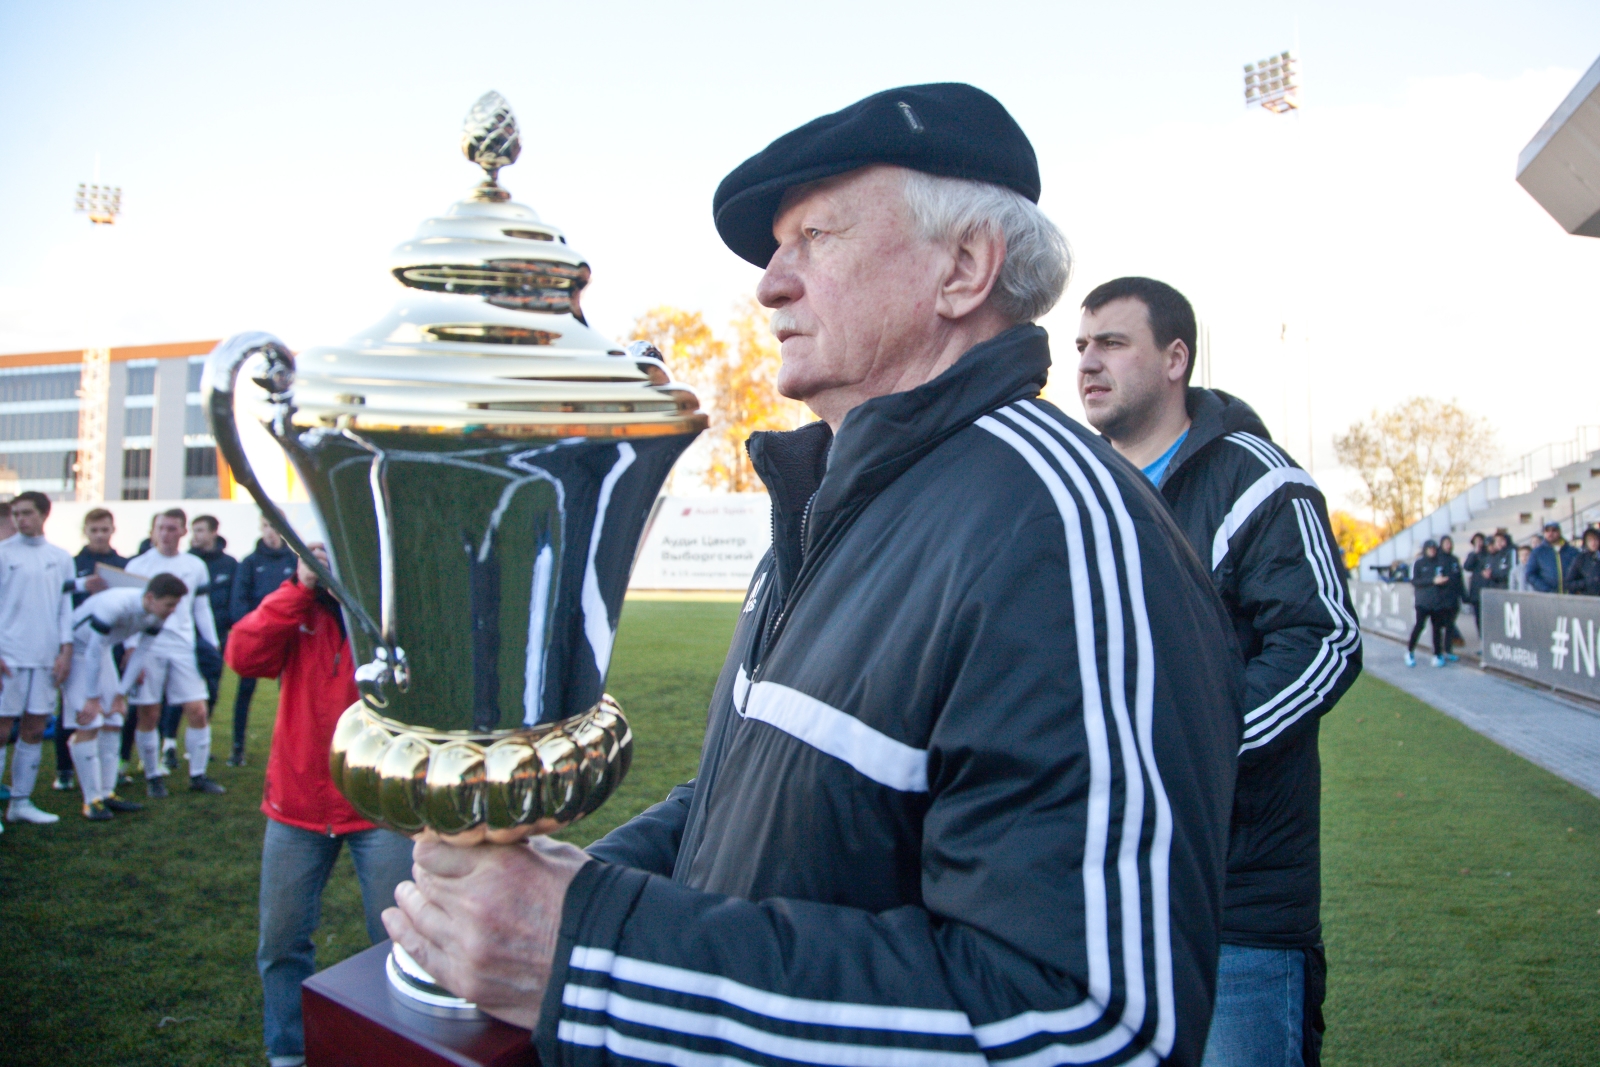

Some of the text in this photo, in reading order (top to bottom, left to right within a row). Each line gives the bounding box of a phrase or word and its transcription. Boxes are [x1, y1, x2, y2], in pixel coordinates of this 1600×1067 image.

[662, 535, 746, 547] Ауди Центр
[661, 550, 754, 563] Выборгский
[1489, 642, 1538, 670] NOVA ARENA
[1550, 616, 1600, 678] #N
